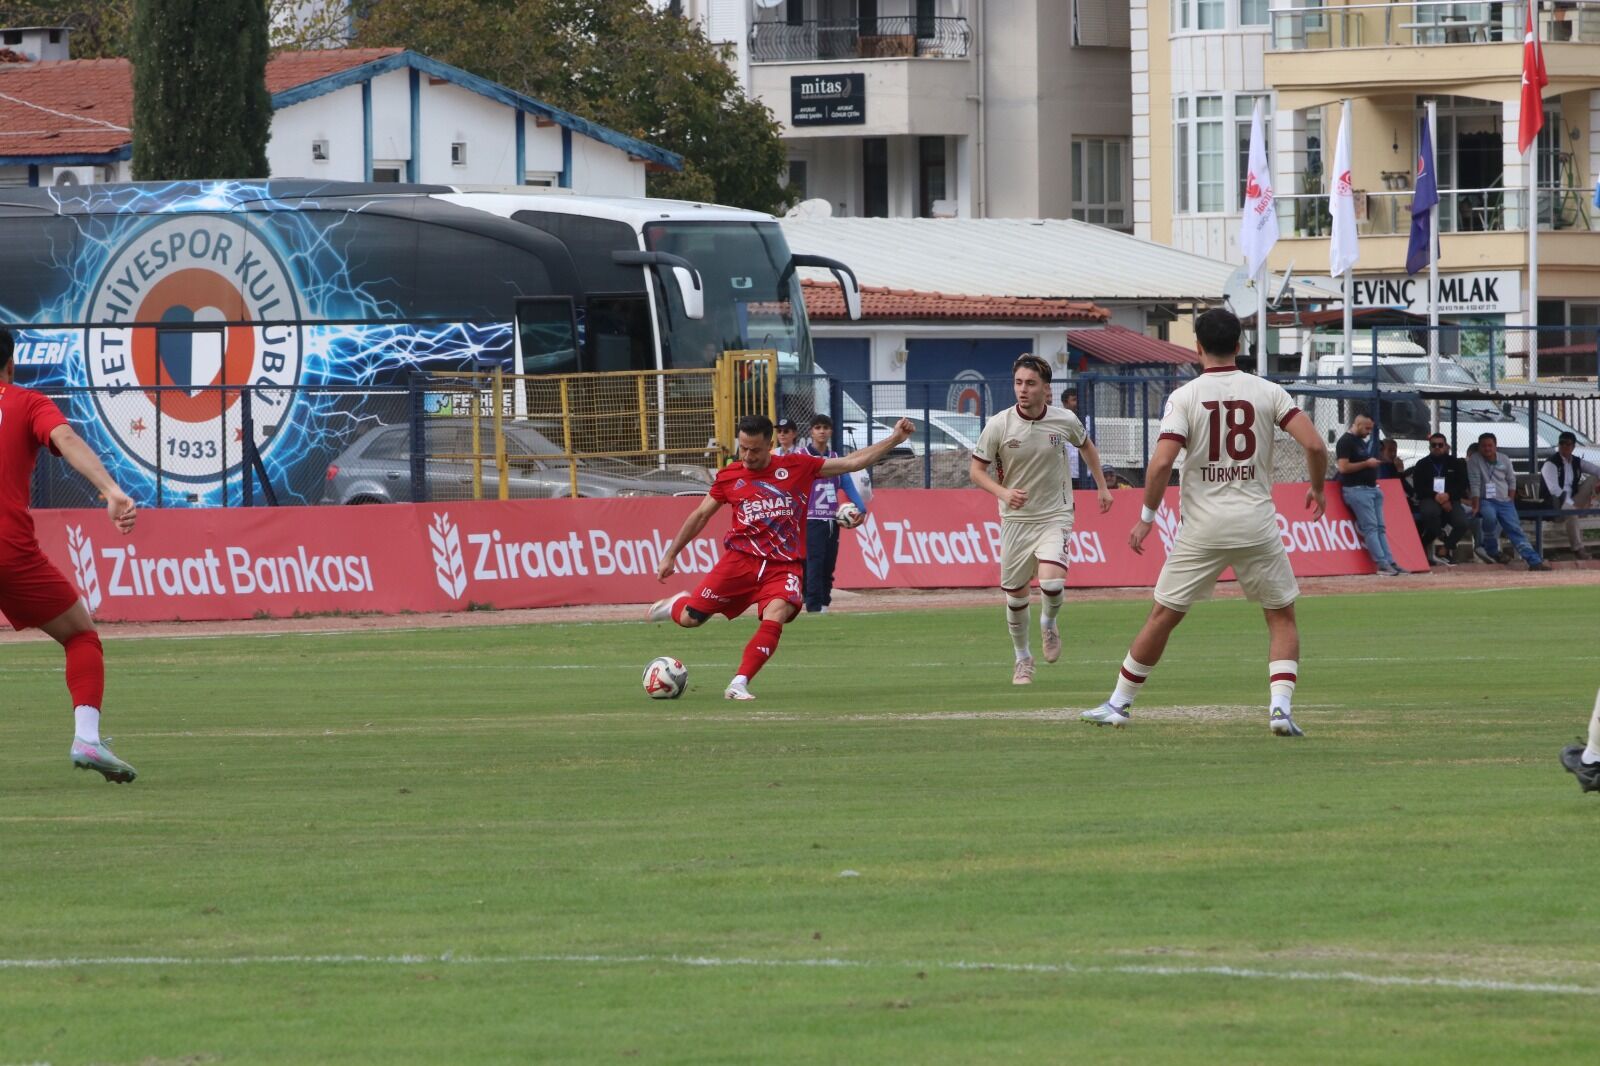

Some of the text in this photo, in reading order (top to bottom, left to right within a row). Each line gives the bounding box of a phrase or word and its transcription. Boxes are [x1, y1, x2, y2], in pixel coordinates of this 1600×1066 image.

[801, 78, 842, 94] mitas
[1341, 277, 1499, 308] EViNÇ MLAK
[101, 229, 293, 406] FETHİYESPOR KULÜBÜ
[167, 437, 217, 459] 1933
[1201, 400, 1256, 462] 18
[1201, 464, 1255, 482] TÜRKMEN
[743, 497, 793, 514] ESNAF
[467, 529, 589, 580] Ziraat
[883, 519, 987, 564] Ziraat
[983, 521, 1106, 564] Bası
[102, 544, 375, 597] Ziraat Bankası
